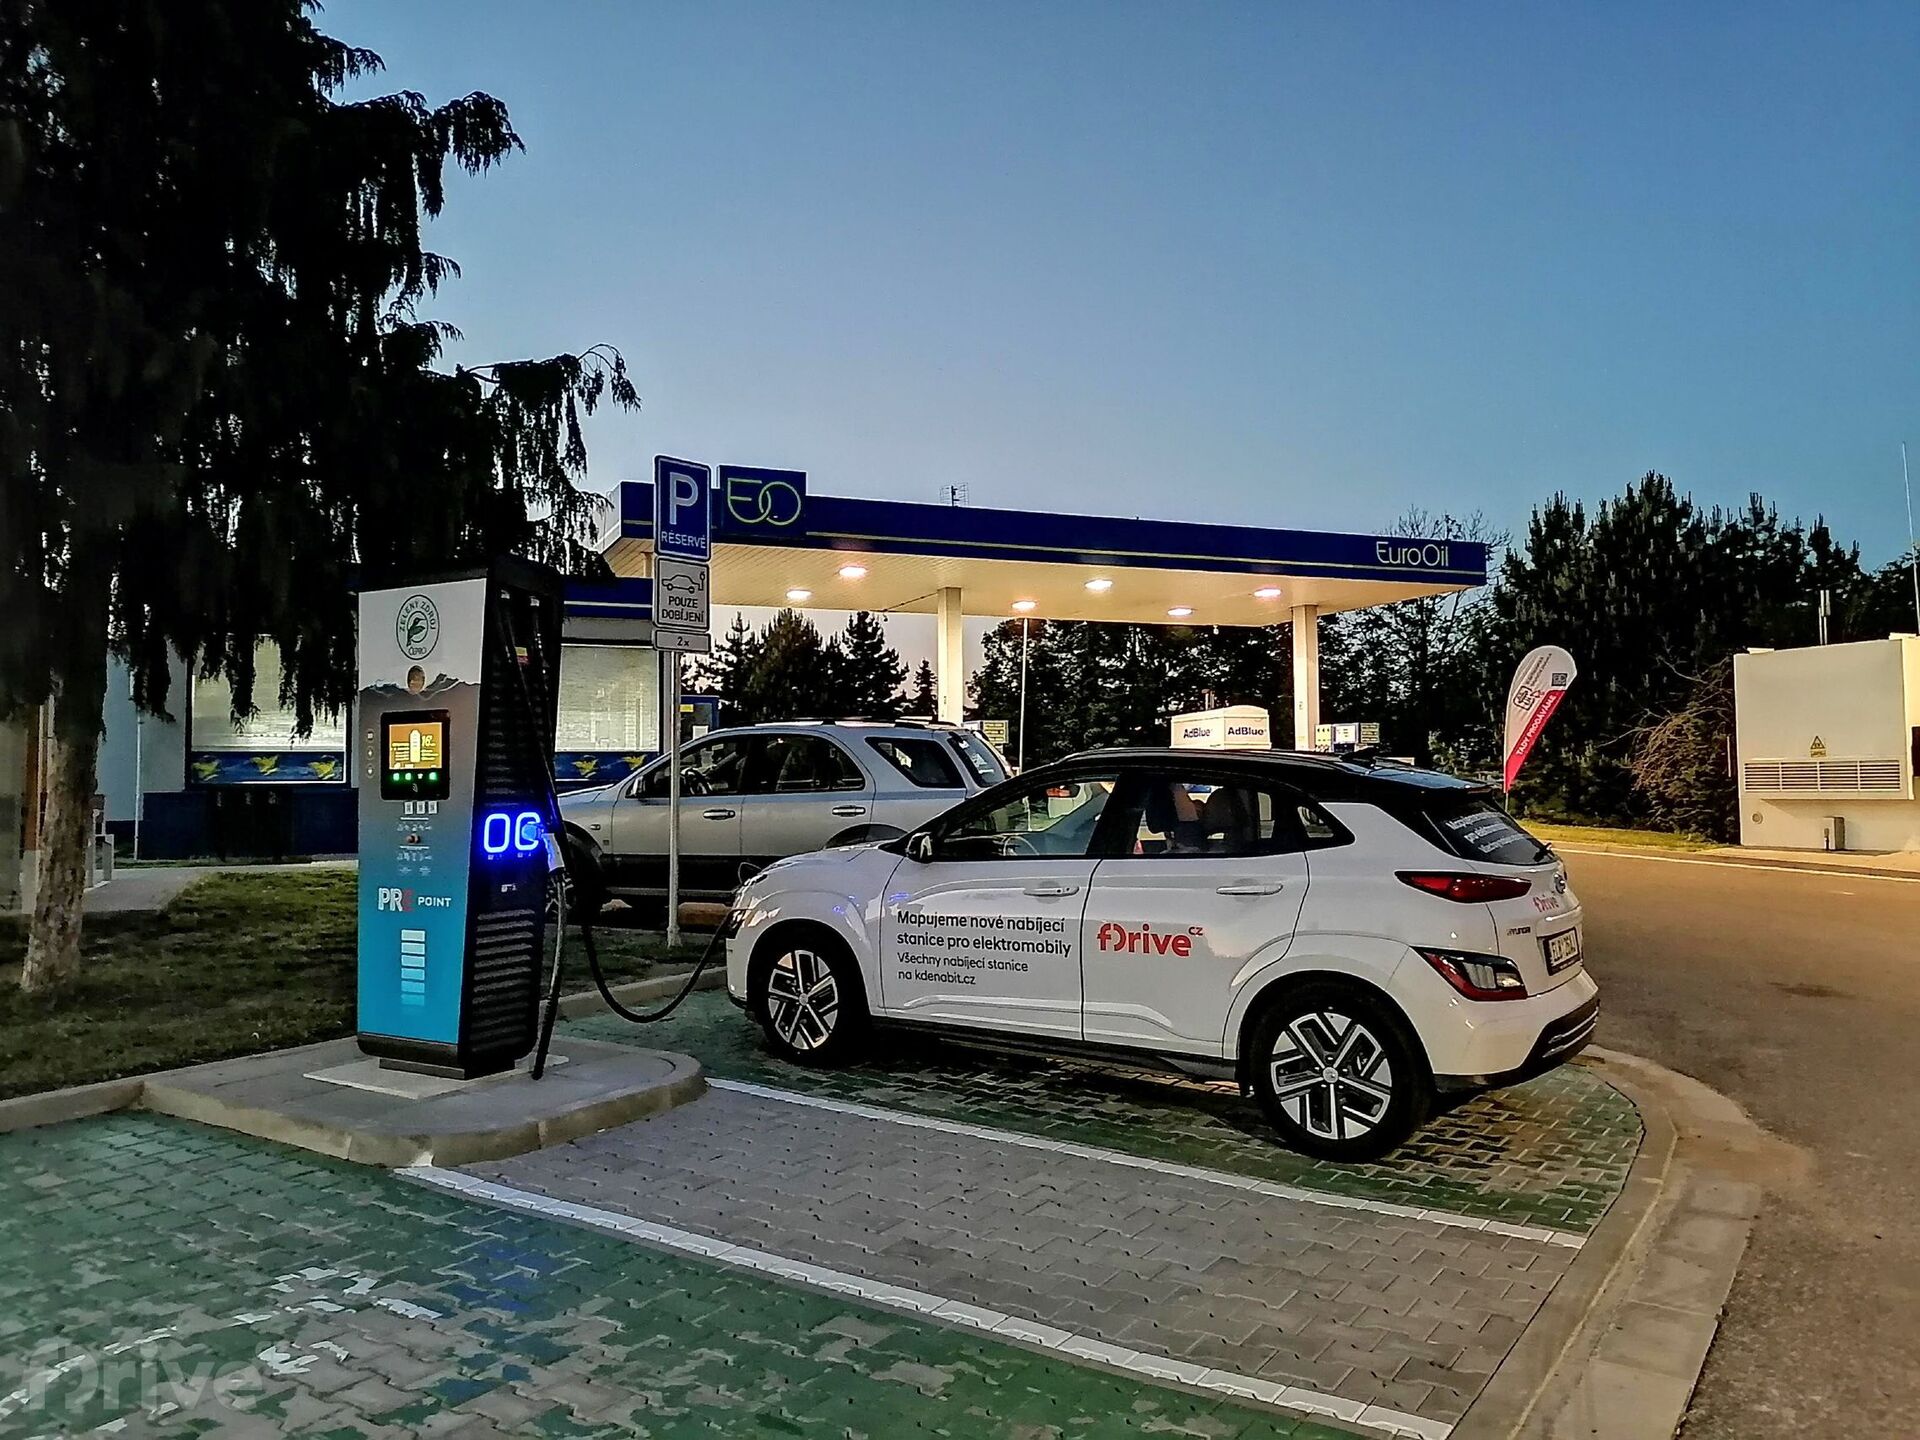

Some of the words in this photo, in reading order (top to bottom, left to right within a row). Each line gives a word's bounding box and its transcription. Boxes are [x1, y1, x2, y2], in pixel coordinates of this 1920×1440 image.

[669, 472, 699, 525] P
[661, 530, 706, 549] RÉSERVÉ
[1376, 541, 1449, 567] EuroOil
[668, 595, 698, 609] POUZE
[661, 608, 705, 624] DOBÍJENÍ
[1183, 727, 1212, 739] AdBlue
[1227, 726, 1264, 736] AdBlue
[417, 896, 452, 907] POINT
[897, 910, 968, 929] Mapujeme
[970, 914, 1005, 929] nové
[1006, 916, 1066, 935] nabíjecí
[896, 931, 945, 947] stanice
[946, 936, 971, 951] pro
[972, 935, 1072, 959] elektromobily
[897, 951, 942, 969] Všechny
[943, 955, 986, 970] nabíjecí
[987, 958, 1029, 973] stanice
[898, 970, 913, 981] na
[914, 968, 977, 986] kdenabit.cz
